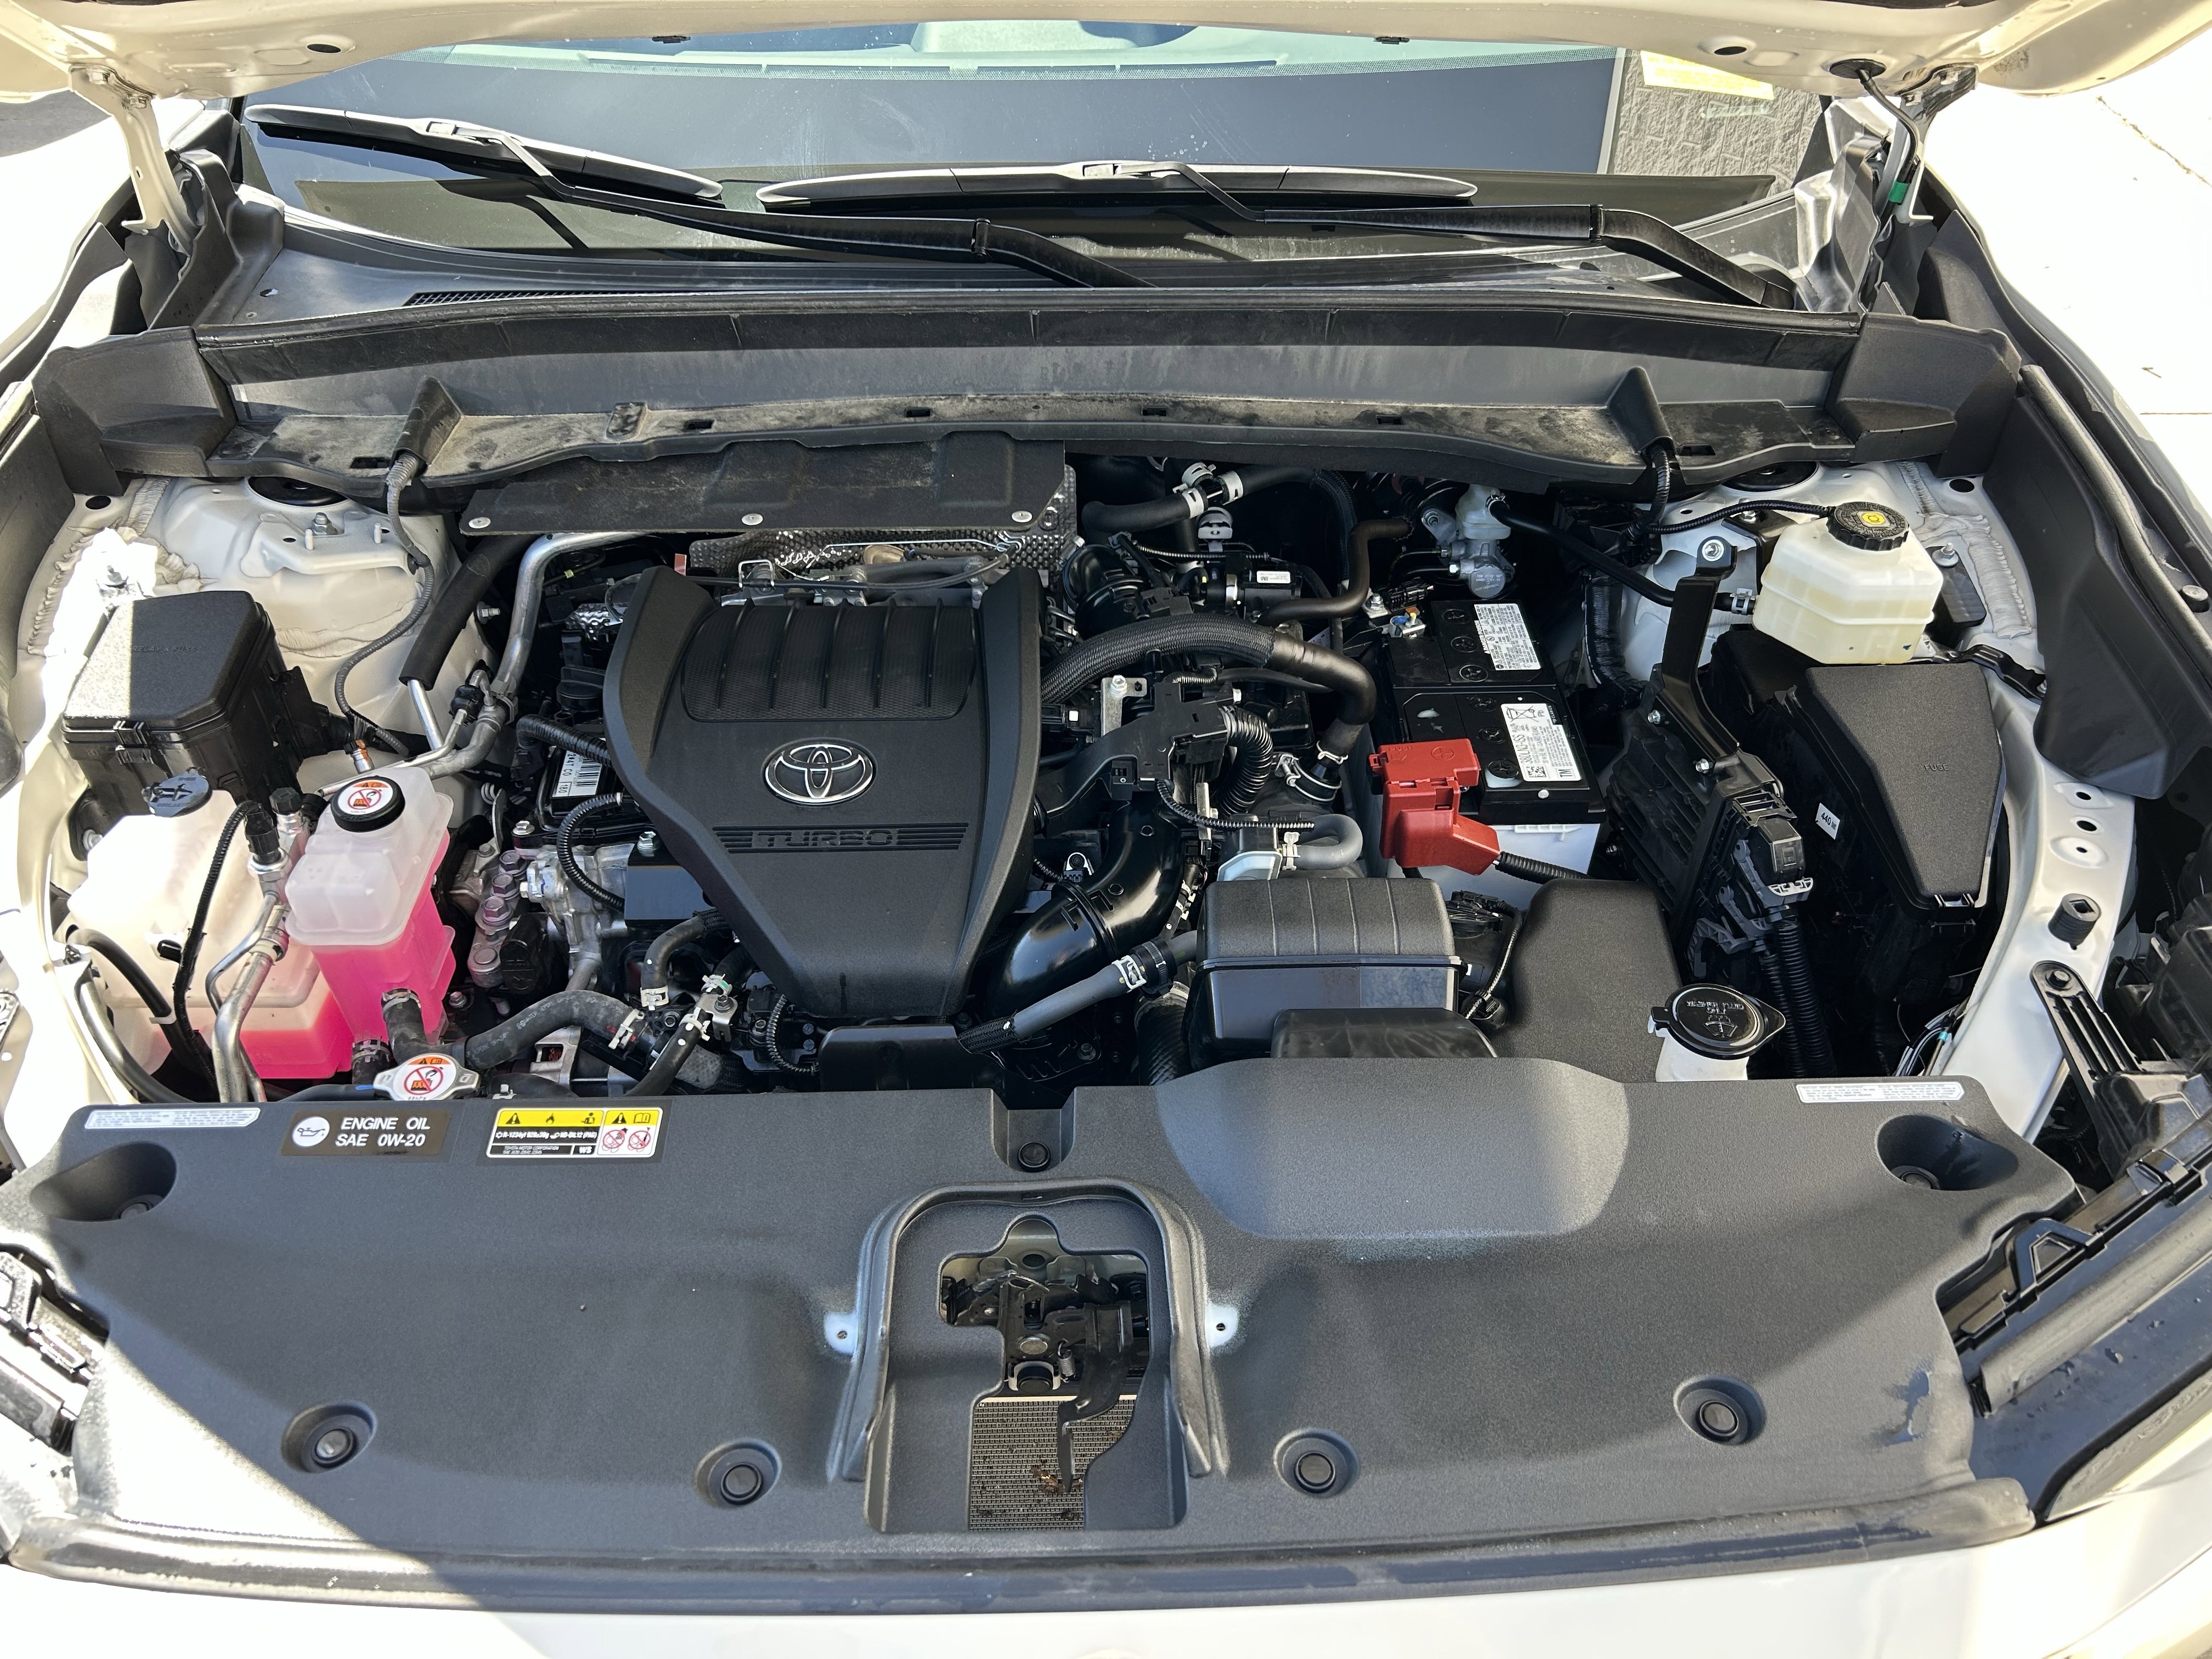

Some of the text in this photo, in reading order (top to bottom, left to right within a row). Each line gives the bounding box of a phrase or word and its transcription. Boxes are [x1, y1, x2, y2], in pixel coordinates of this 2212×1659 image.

[1558, 769, 1573, 777] TM
[1924, 763, 1949, 771] FUSE
[1821, 812, 1831, 826] 440
[758, 830, 893, 847] TURBO
[340, 1117, 431, 1130] ENGINE OIL
[335, 1133, 426, 1147] SAE 0W-20
